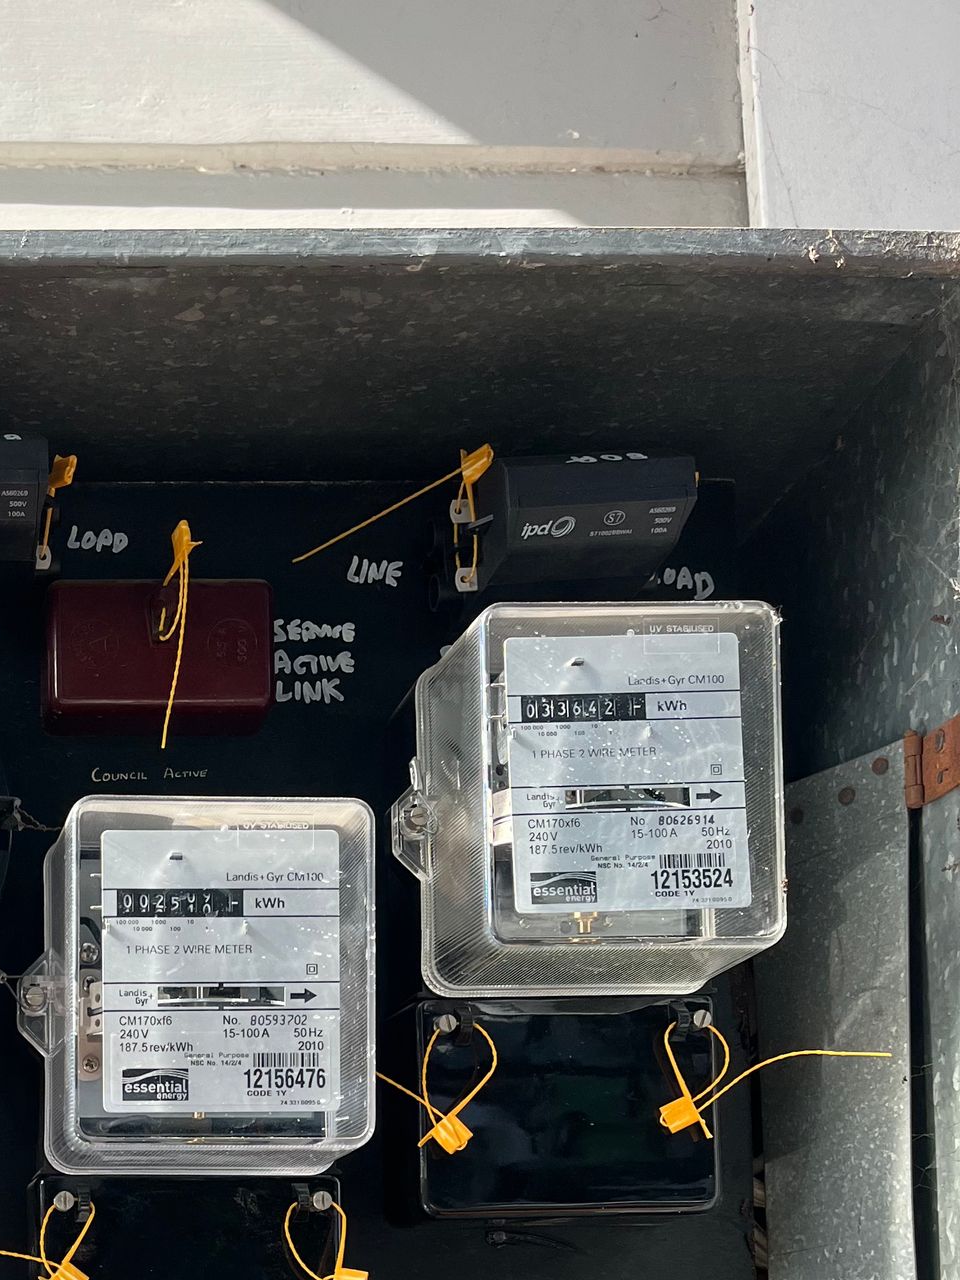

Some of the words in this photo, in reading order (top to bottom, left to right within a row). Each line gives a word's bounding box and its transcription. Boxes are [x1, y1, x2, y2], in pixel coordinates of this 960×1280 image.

[521, 521, 552, 539] ipd
[67, 526, 128, 554] LOAD
[347, 556, 403, 586] LINE
[649, 567, 714, 600] OAD
[274, 650, 355, 674] ACTIVE
[276, 679, 344, 704] LINK
[657, 701, 687, 712] kWh
[541, 750, 575, 758] PHASE
[589, 749, 616, 757] WIRE
[619, 747, 656, 756] METER
[91, 768, 148, 782] COUNCIL
[164, 768, 208, 778] ACTIVE
[528, 818, 580, 828] CM170xf6
[659, 815, 714, 825] 80626914
[707, 840, 732, 849] 2010
[651, 869, 733, 889] 12153524
[533, 884, 596, 896] essential
[255, 898, 285, 909] kWh
[566, 895, 595, 903] energy
[135, 946, 169, 954] PHASE
[174, 946, 179, 954] 2
[183, 945, 211, 954] WIRE
[215, 945, 252, 953] METER
[119, 1016, 172, 1025] CM170xf6
[251, 1015, 307, 1025] 80593702
[298, 1041, 324, 1050] 2010
[244, 1069, 326, 1088] 12156476
[125, 1080, 188, 1093] essential
[157, 1092, 188, 1100] energy
